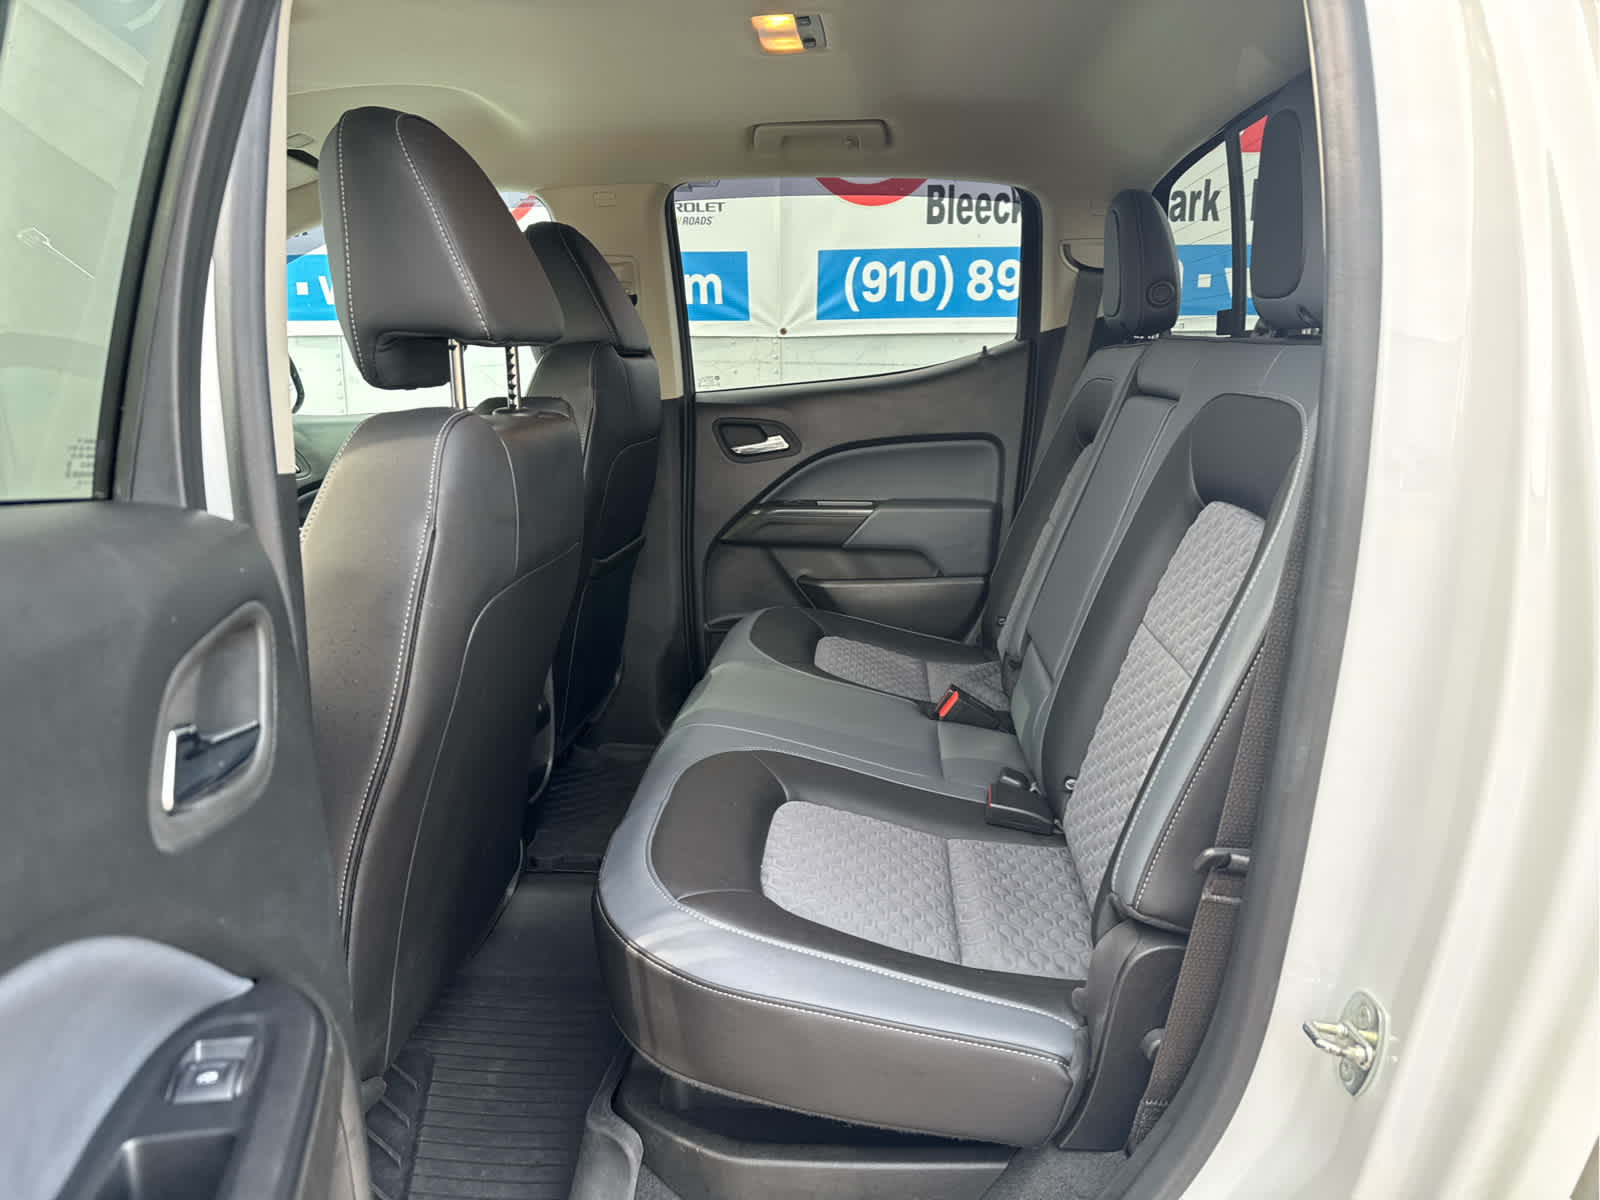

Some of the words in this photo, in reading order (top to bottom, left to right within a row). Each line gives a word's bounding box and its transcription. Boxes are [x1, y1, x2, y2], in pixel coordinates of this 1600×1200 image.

[682, 216, 713, 226] ROADS
[1169, 178, 1221, 222] ark
[844, 254, 955, 312] (910)
[966, 258, 1021, 302] 89
